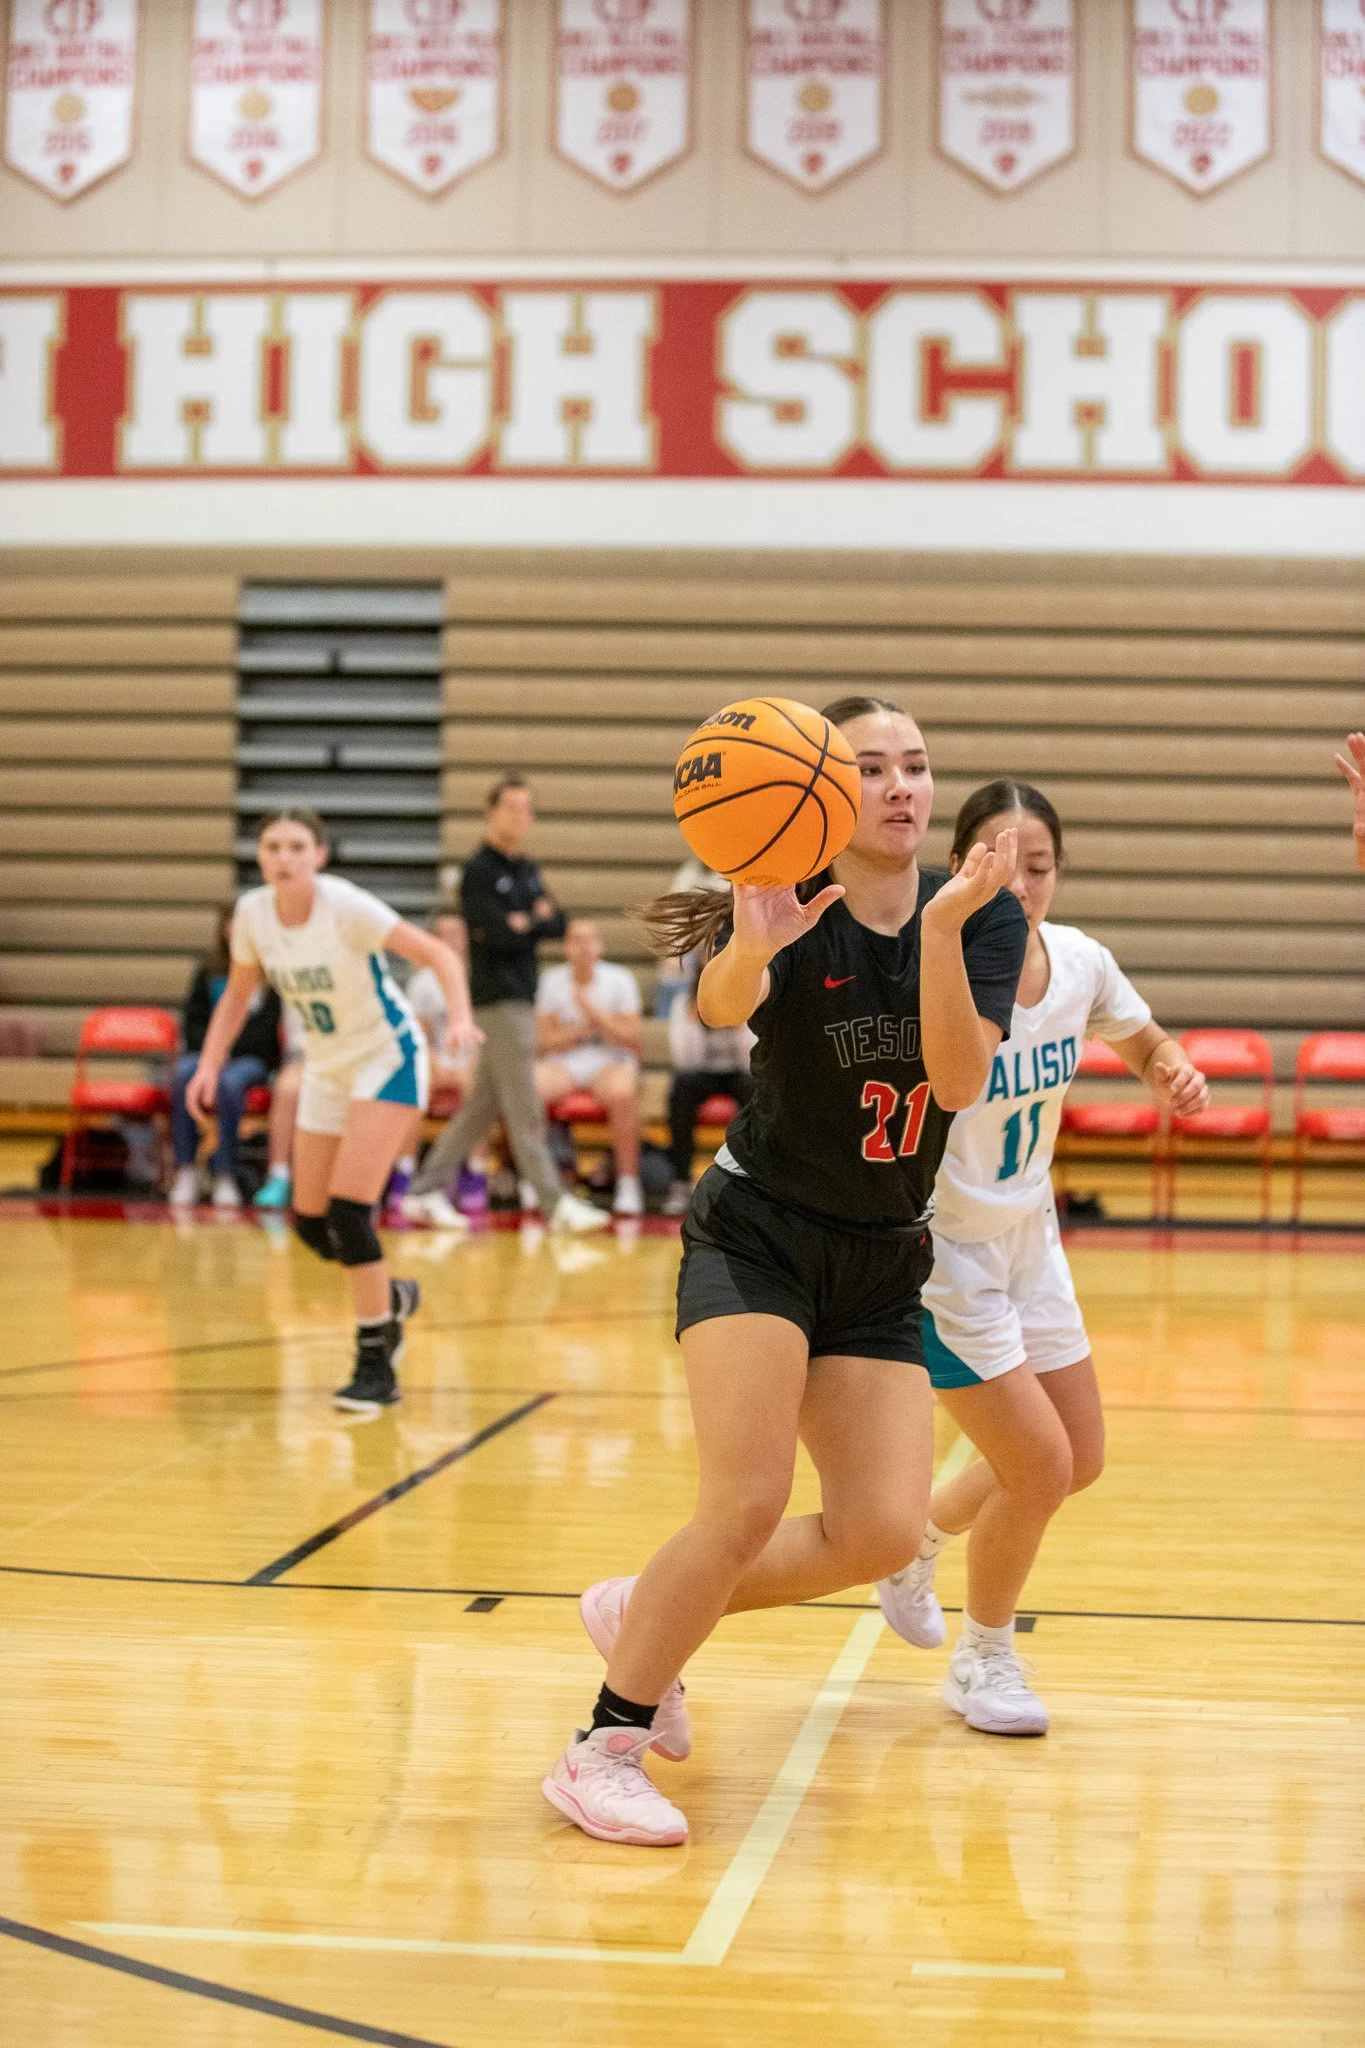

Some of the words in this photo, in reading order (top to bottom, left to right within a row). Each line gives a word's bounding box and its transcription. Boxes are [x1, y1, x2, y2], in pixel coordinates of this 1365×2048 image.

[118, 287, 656, 471] HIGH
[985, 1035, 1077, 1104] ALISO
[860, 1080, 931, 1163] 21
[994, 1100, 1048, 1182] 11
